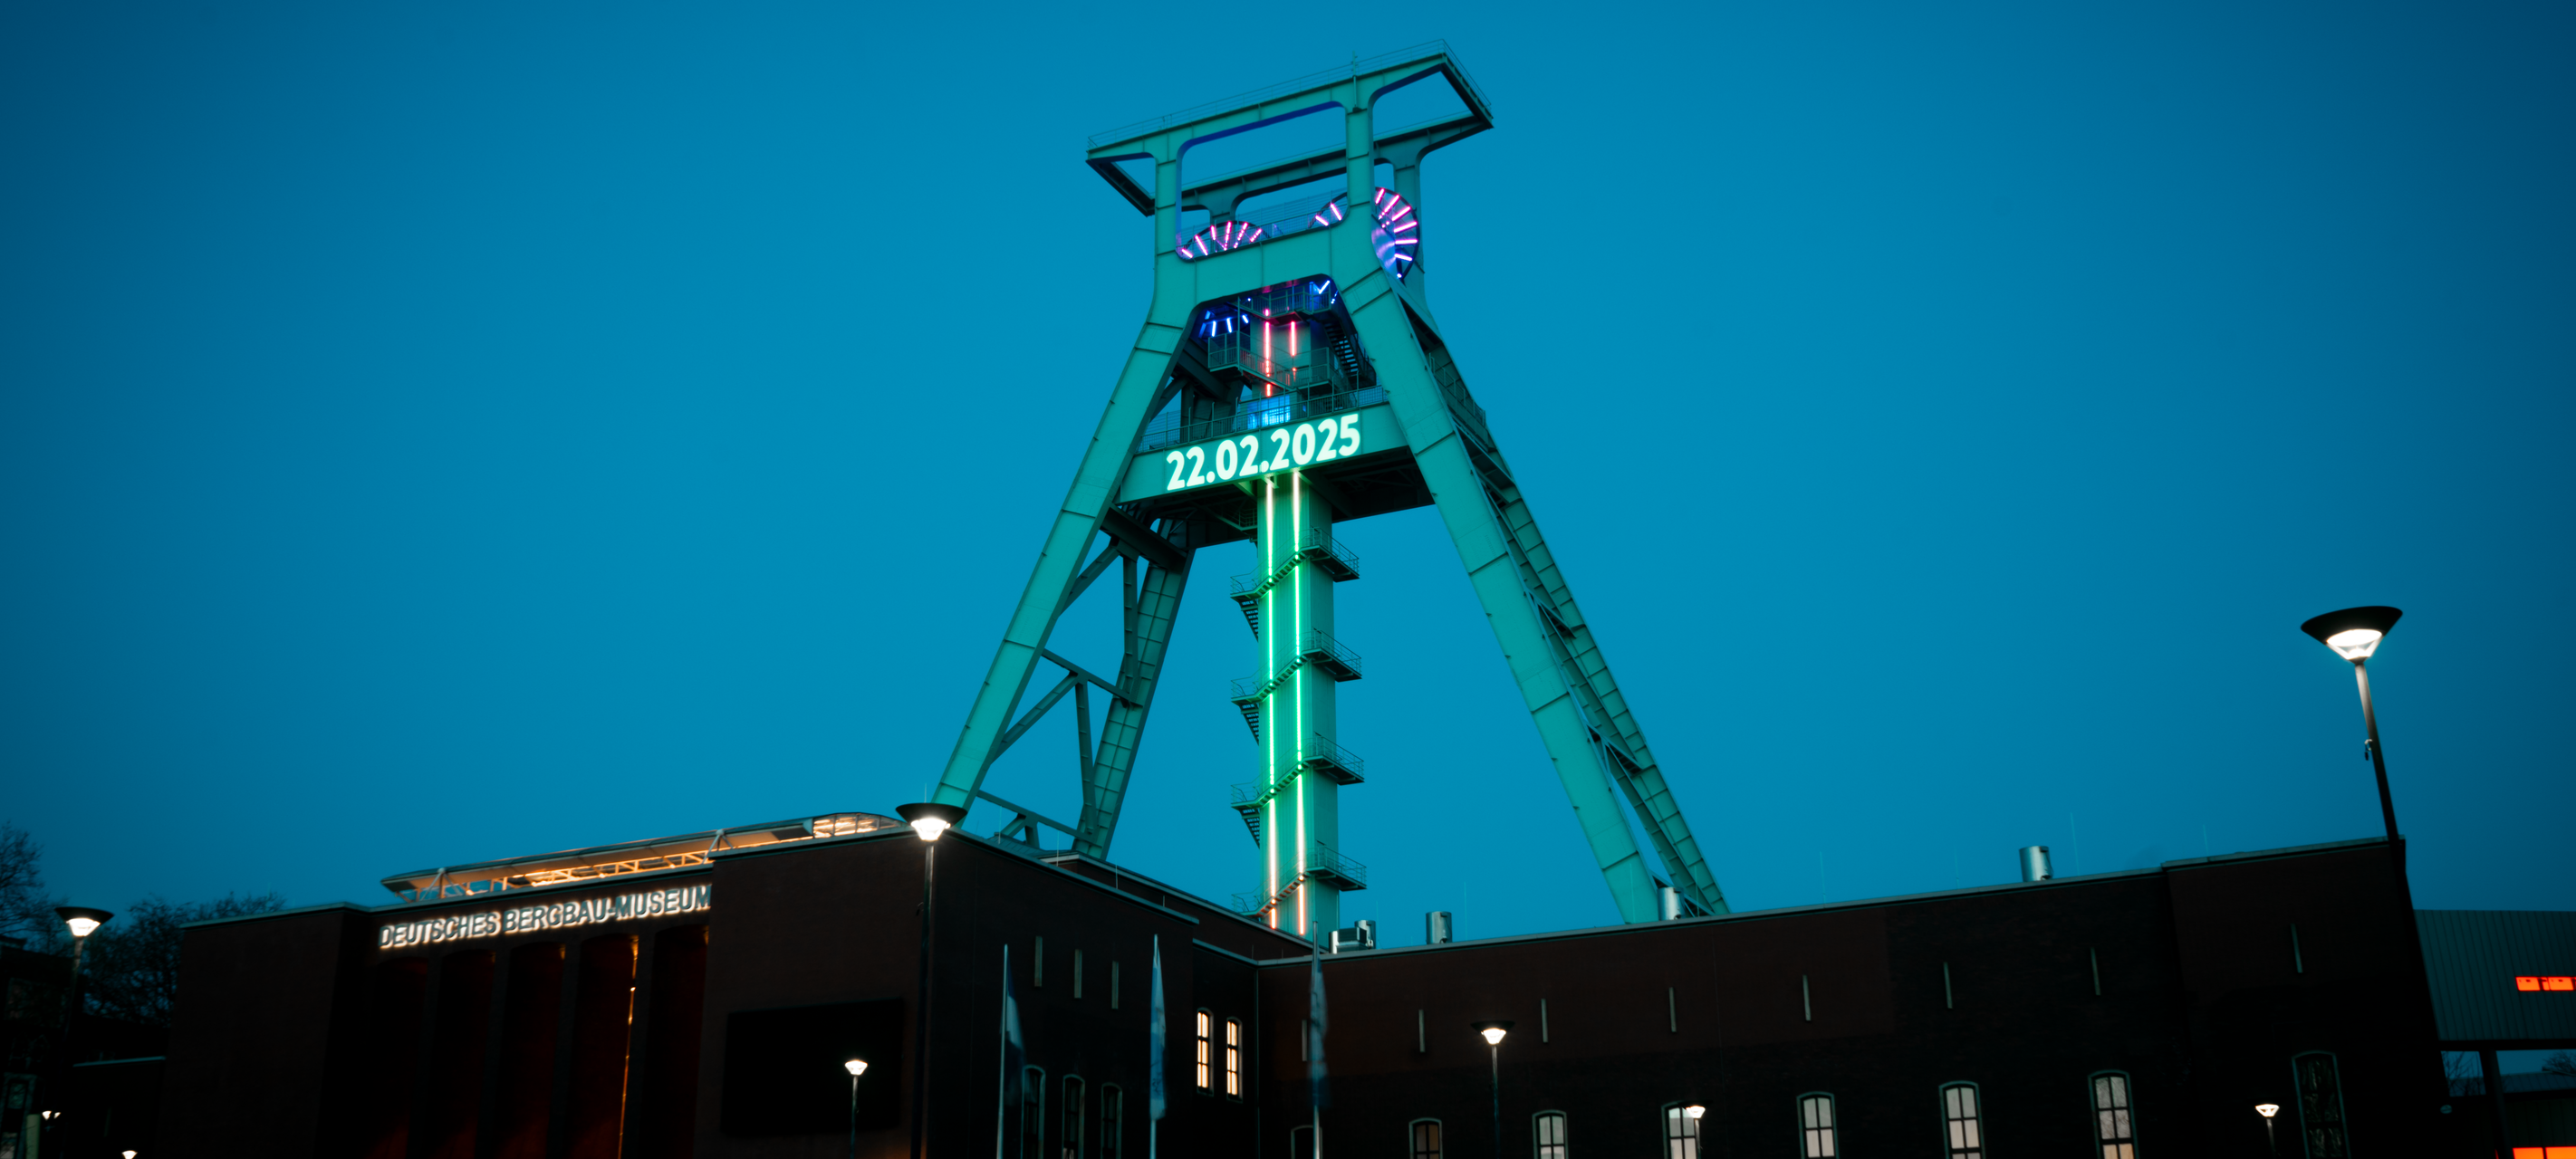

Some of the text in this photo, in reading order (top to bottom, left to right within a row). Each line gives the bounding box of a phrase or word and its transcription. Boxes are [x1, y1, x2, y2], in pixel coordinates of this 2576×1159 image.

[1166, 413, 1360, 491] 22.02.2025
[379, 885, 712, 948] DEUTSCHES BERGBAU-MUSEUM
